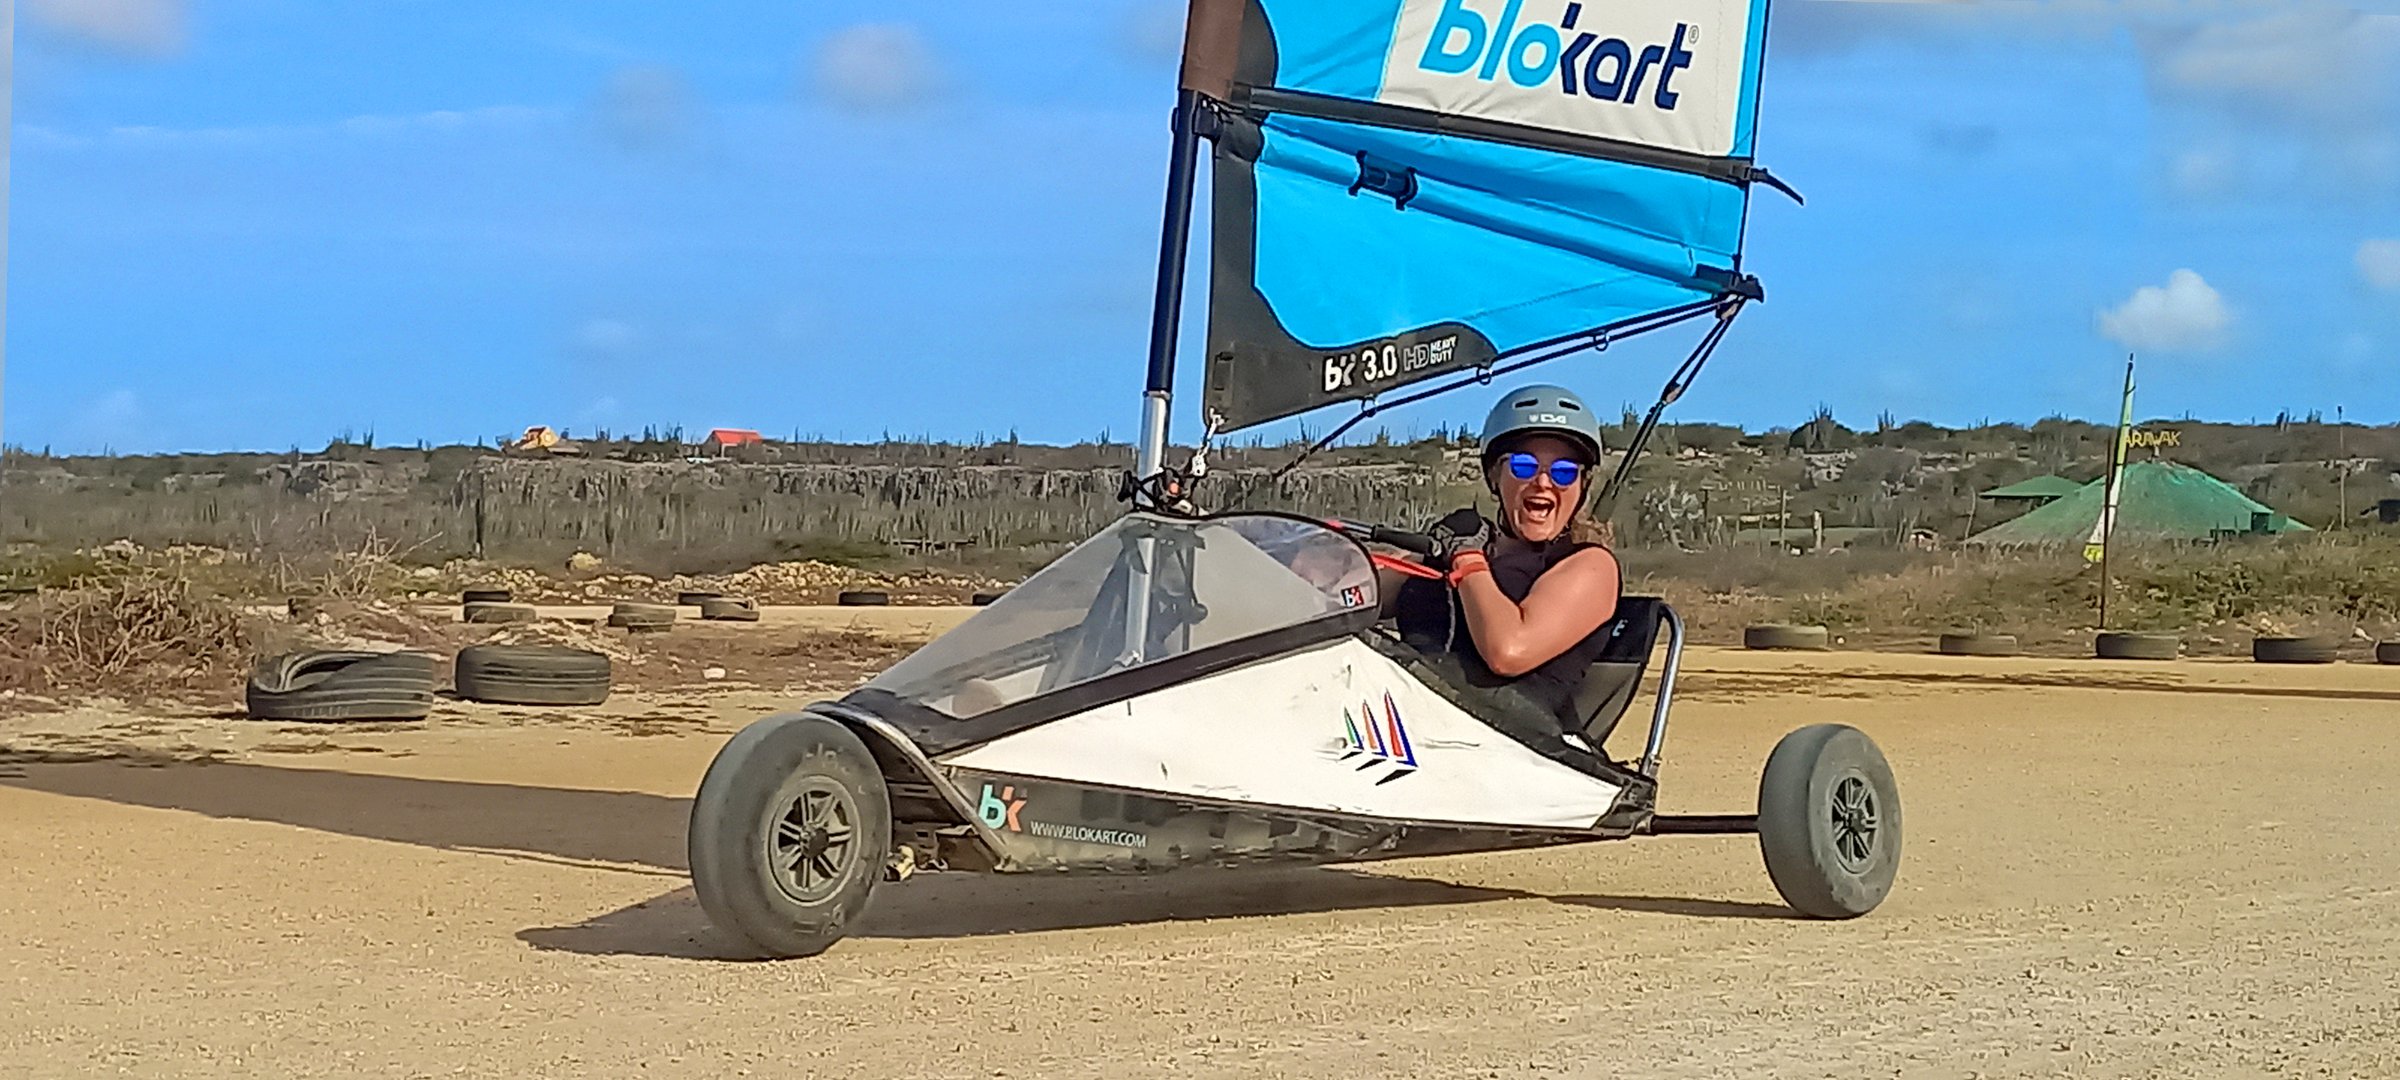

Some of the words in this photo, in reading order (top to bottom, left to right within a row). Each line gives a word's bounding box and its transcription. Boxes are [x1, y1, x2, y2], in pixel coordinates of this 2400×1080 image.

[1362, 345, 1398, 381] 3.0
[1430, 347, 1453, 365] DUTY
[1030, 821, 1147, 848] WWW.BLOKART.COM
